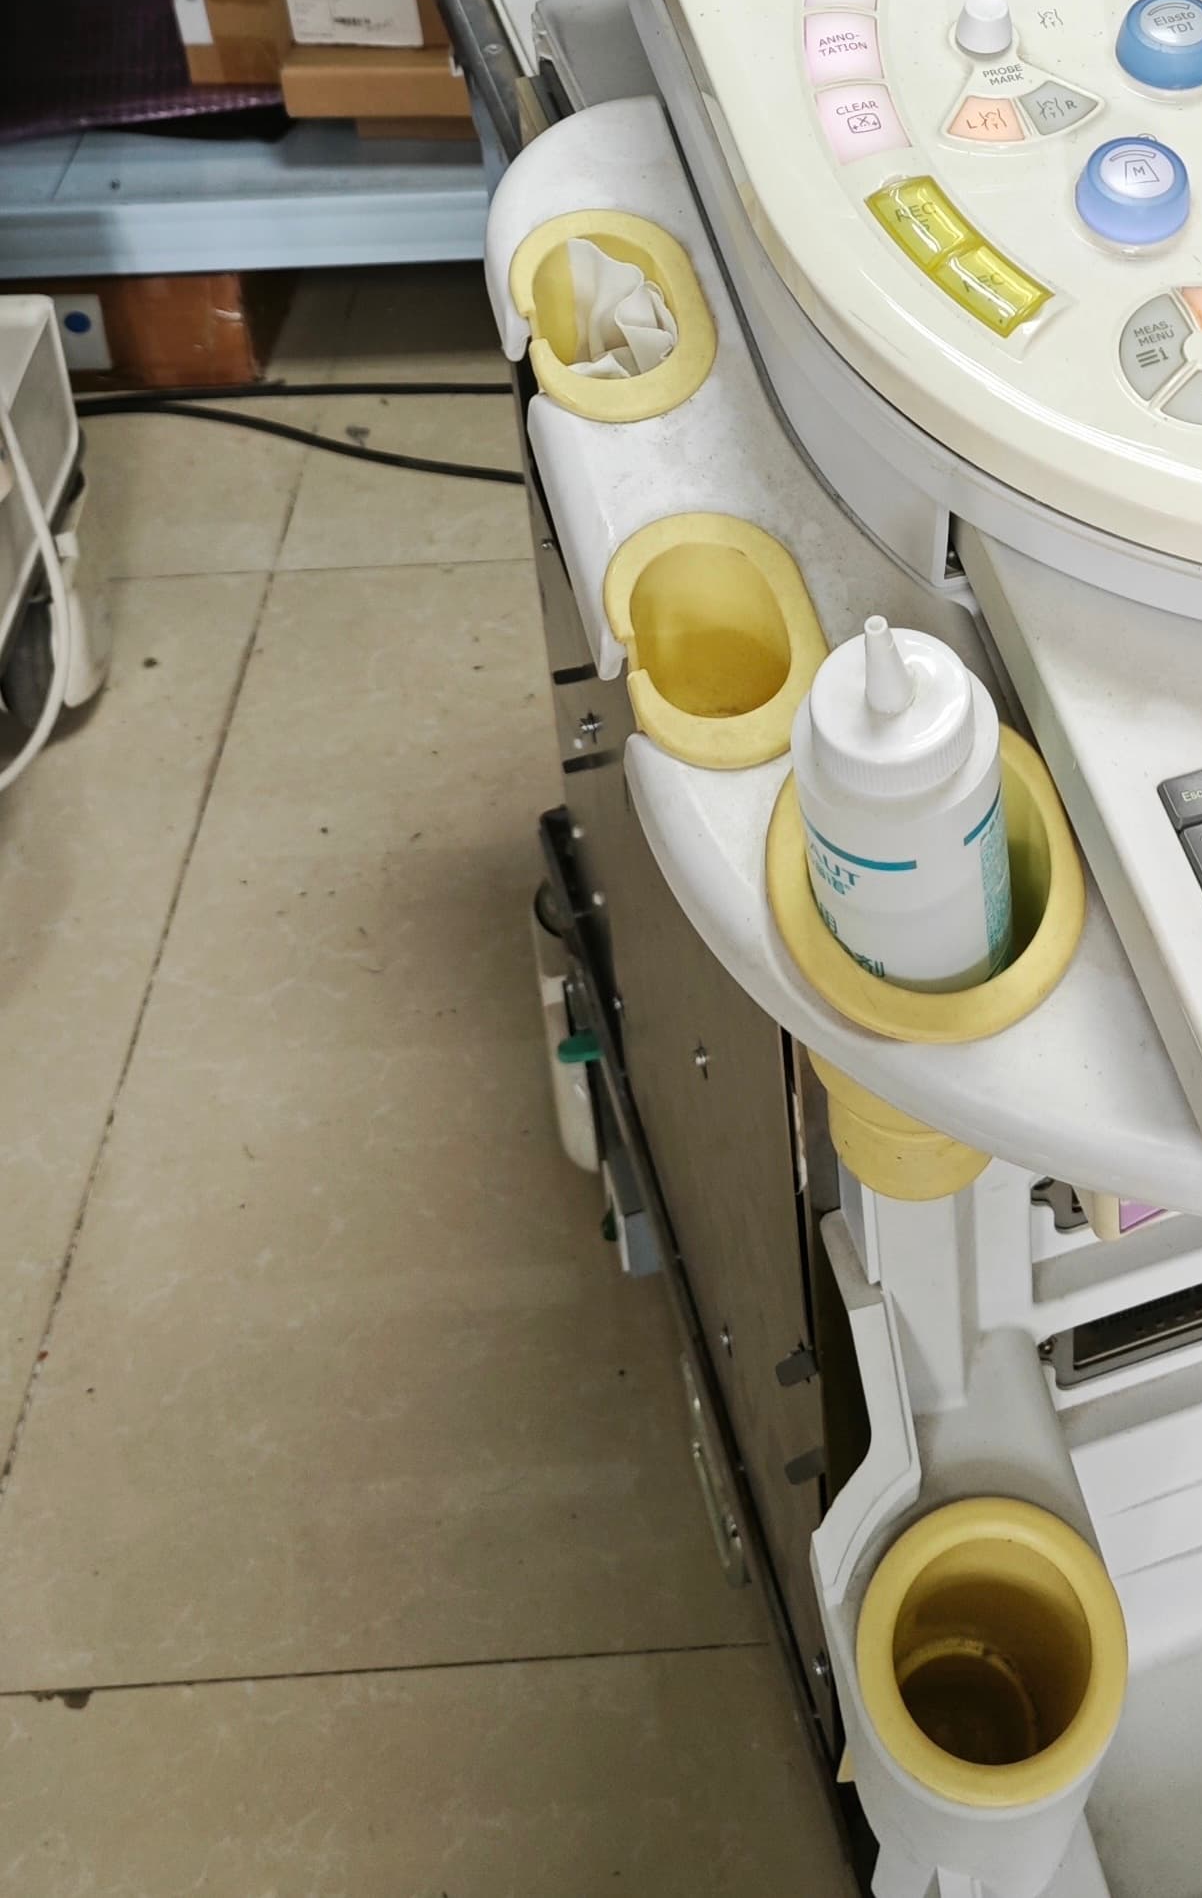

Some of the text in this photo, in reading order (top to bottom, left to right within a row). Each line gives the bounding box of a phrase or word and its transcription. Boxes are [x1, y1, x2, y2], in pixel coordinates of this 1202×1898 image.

[1153, 9, 1196, 27] Elasto
[1166, 20, 1195, 36] TDI
[818, 32, 861, 48] ANNO-
[819, 40, 868, 57] TATION
[982, 63, 1023, 79] PROBE
[988, 72, 1025, 87] MARK
[835, 100, 879, 116] CLEAR
[1132, 165, 1147, 177] M
[1133, 319, 1173, 338] MEAS.
[1137, 328, 1175, 346] MENU
